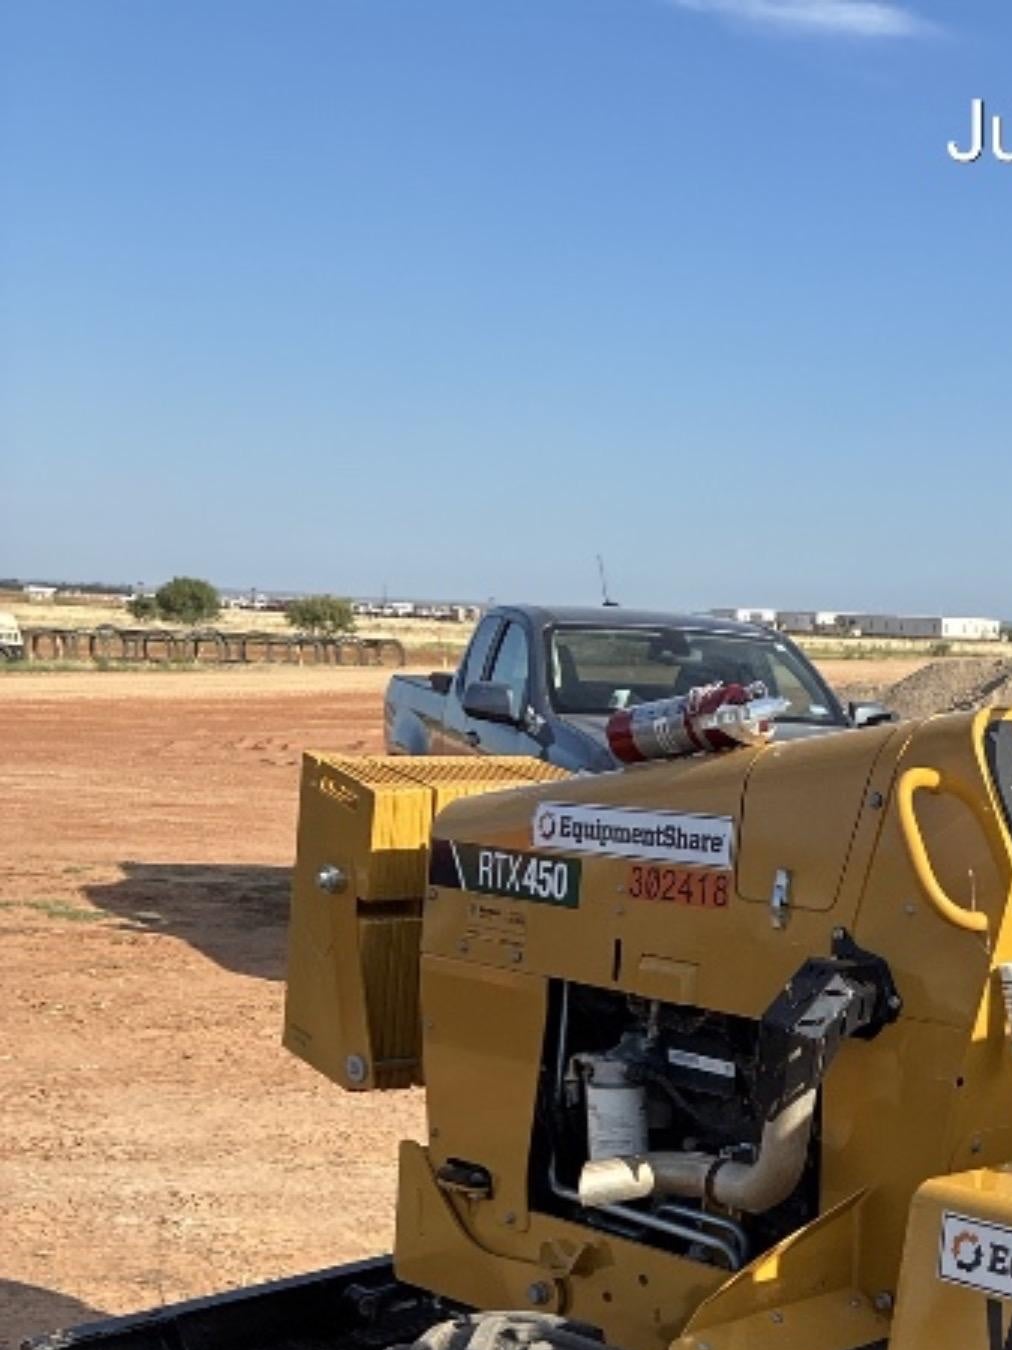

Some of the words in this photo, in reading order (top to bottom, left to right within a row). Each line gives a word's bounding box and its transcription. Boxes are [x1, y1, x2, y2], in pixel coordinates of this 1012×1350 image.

[559, 816, 723, 853] EquipmentShare
[477, 850, 569, 901] RTX450
[628, 865, 729, 907] 302418
